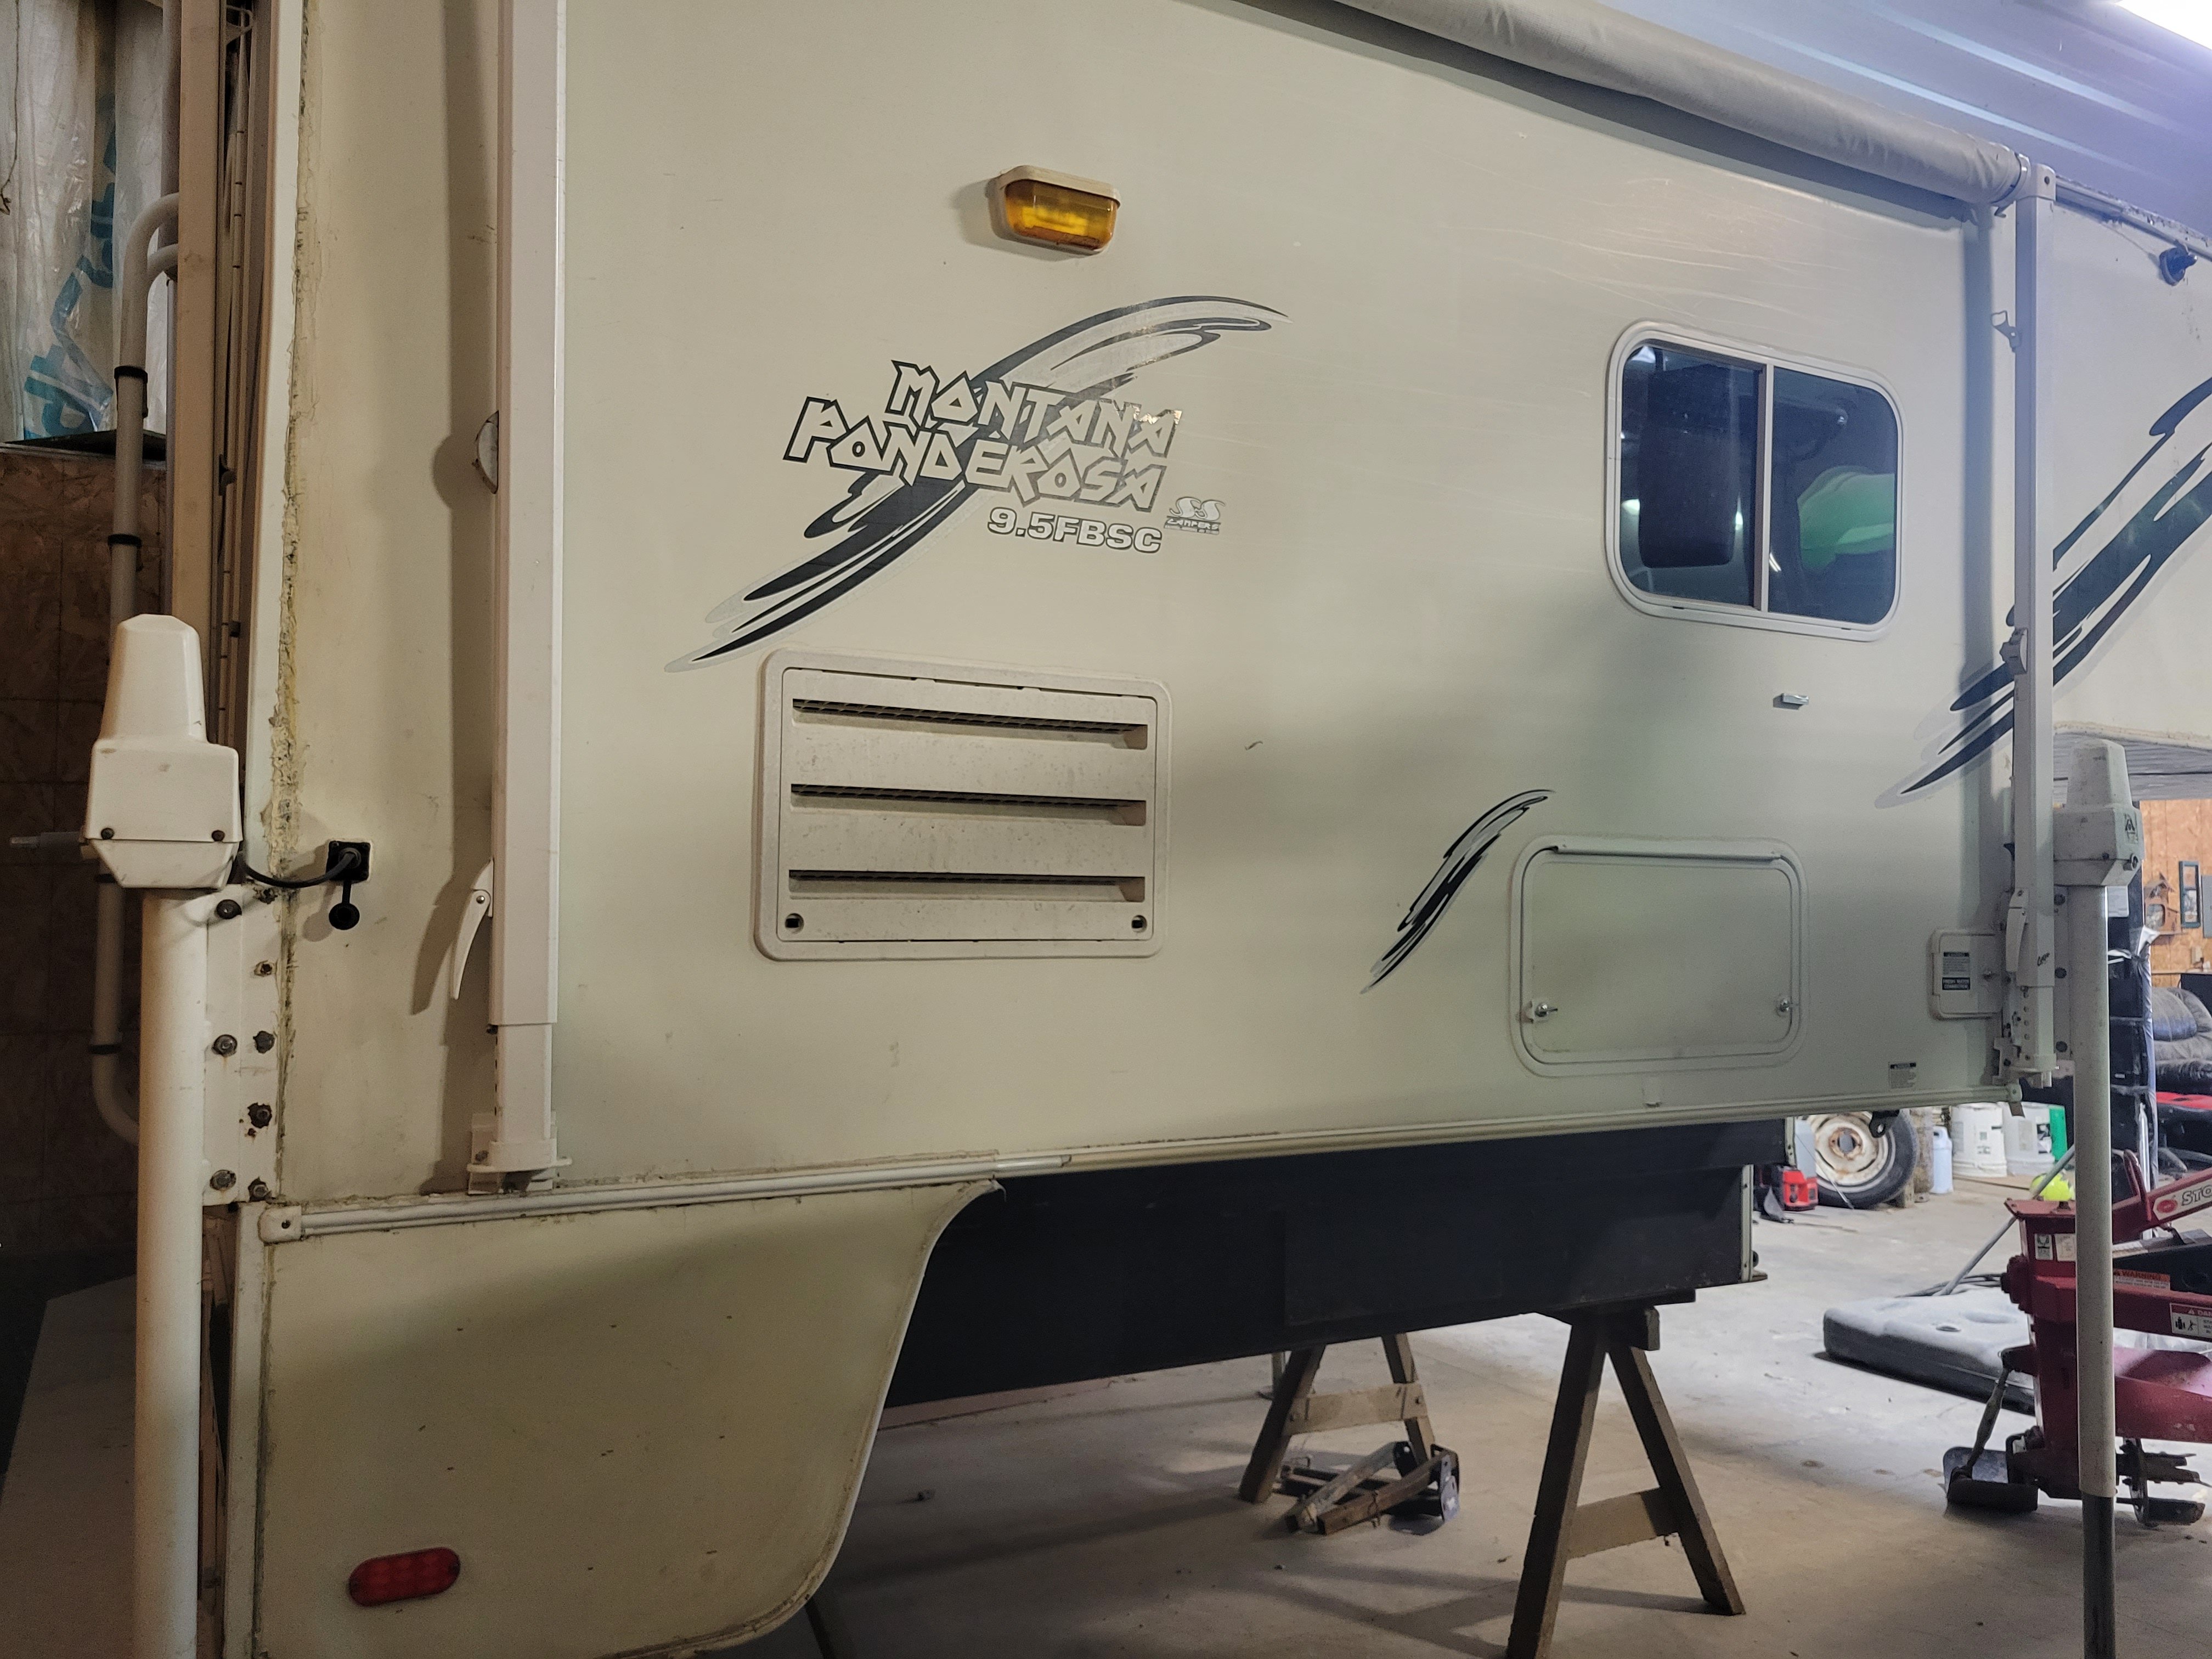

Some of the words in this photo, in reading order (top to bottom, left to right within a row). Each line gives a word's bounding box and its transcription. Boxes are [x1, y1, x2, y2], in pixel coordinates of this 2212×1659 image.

[884, 359, 1182, 459] MONTANA
[782, 396, 1167, 512] PONDEROSA
[987, 506, 1163, 554] 9.5FBSC
[1165, 517, 1220, 531] CAMPERS
